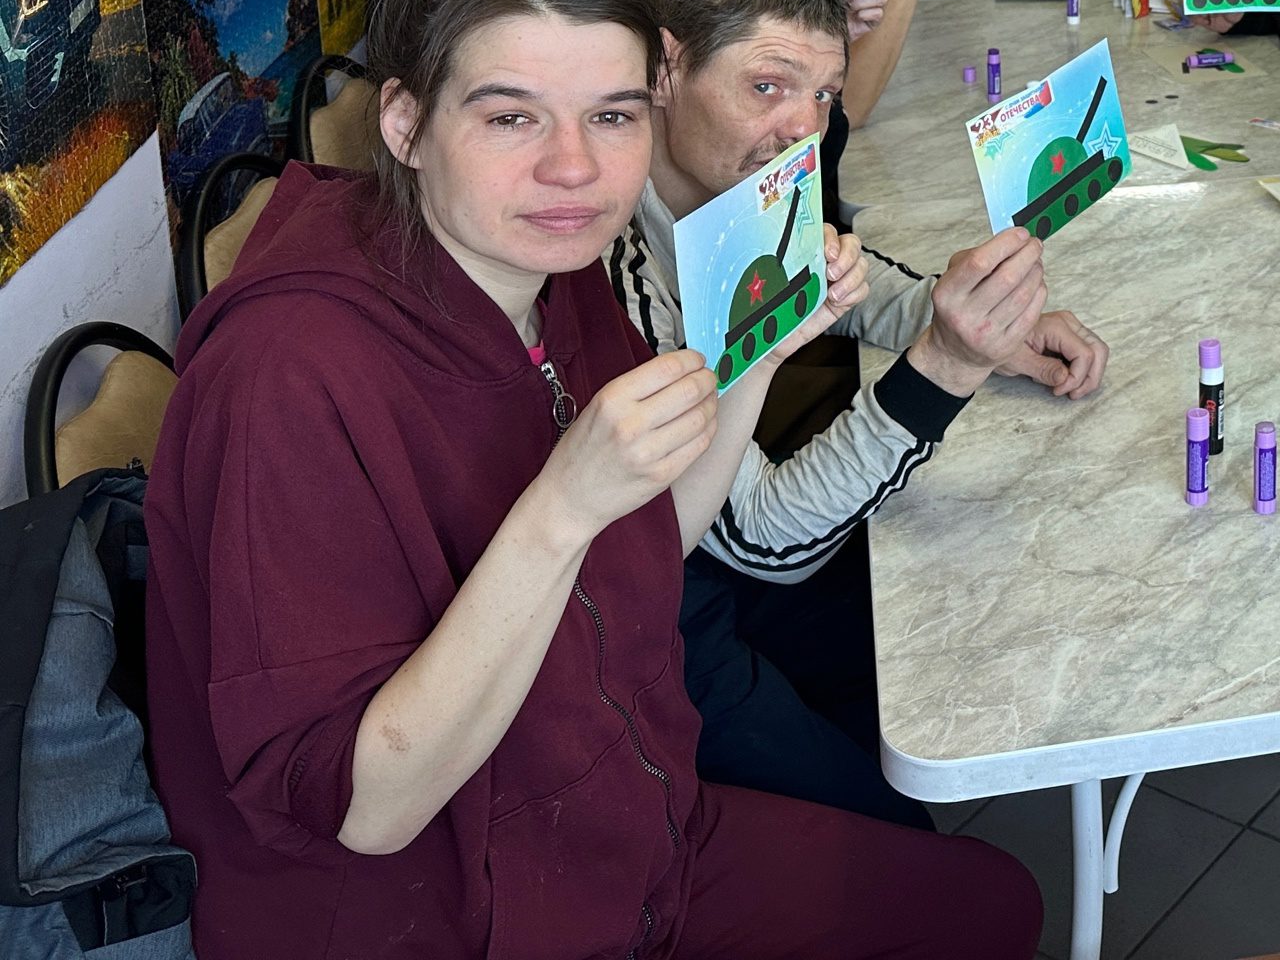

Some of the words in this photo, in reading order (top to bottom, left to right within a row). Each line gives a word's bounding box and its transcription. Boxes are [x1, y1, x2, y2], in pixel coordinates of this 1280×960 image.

[1000, 94, 1039, 122] ОТЕЧЕСТВА
[975, 114, 994, 134] 23
[762, 174, 776, 197] 23
